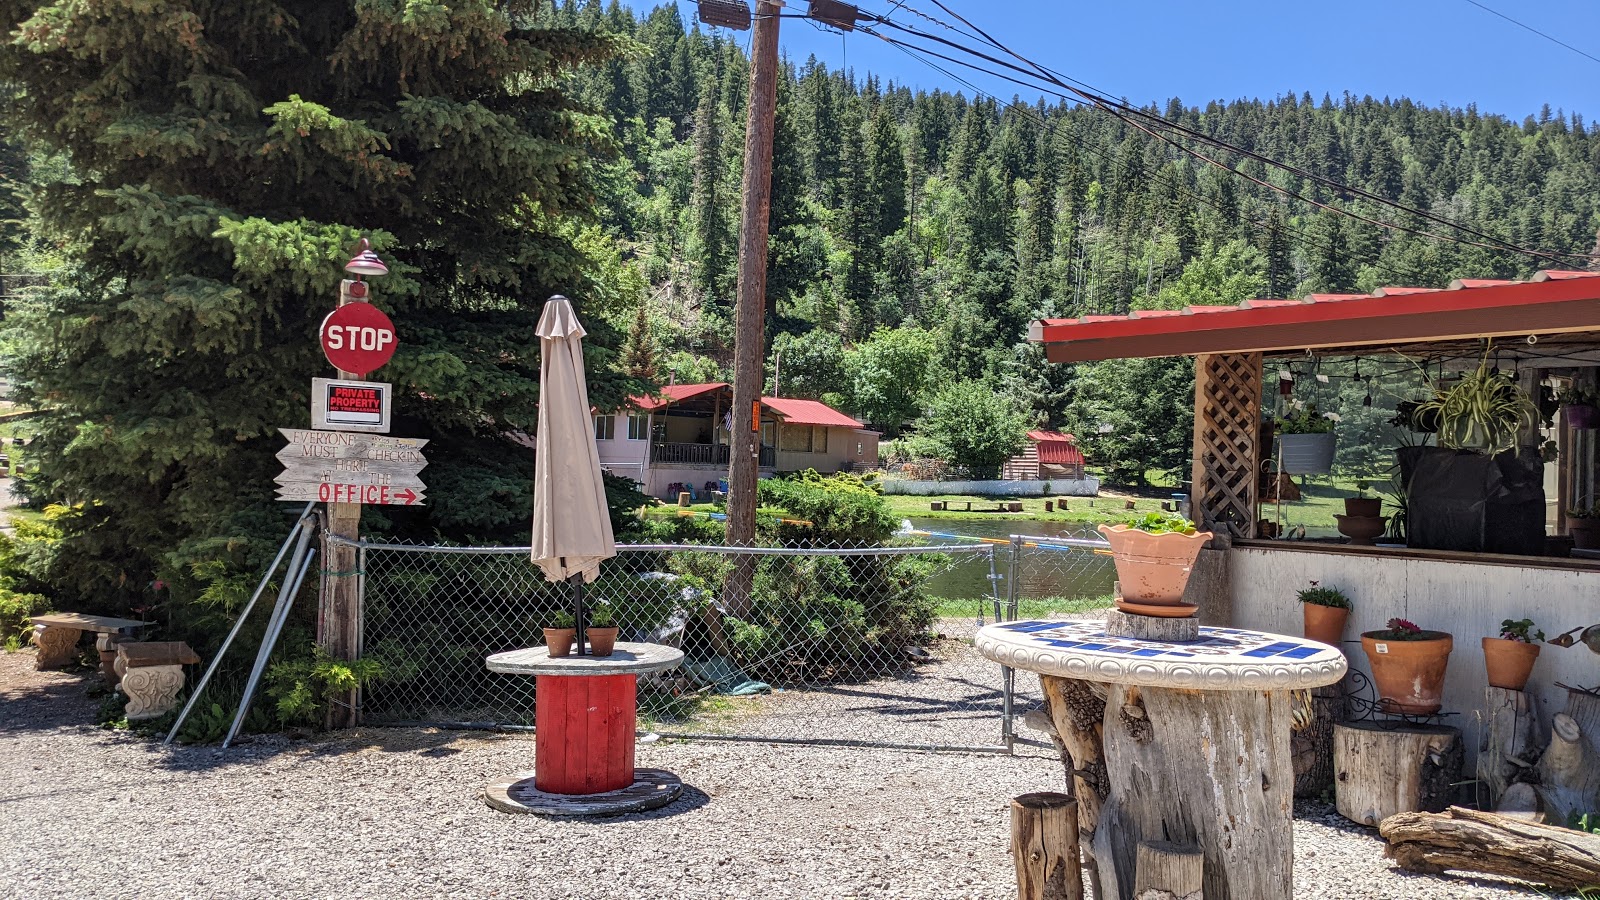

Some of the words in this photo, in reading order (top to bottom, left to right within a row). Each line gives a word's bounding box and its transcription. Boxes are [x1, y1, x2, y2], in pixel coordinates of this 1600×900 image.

[328, 325, 393, 351] STOP
[335, 388, 375, 399] PRIVATE
[330, 397, 380, 408] PROPERTY
[293, 431, 356, 446] EVERYONE
[301, 445, 338, 458] MUST
[320, 470, 333, 482] AT
[369, 472, 392, 485] THE
[318, 483, 390, 504] OFFICE
